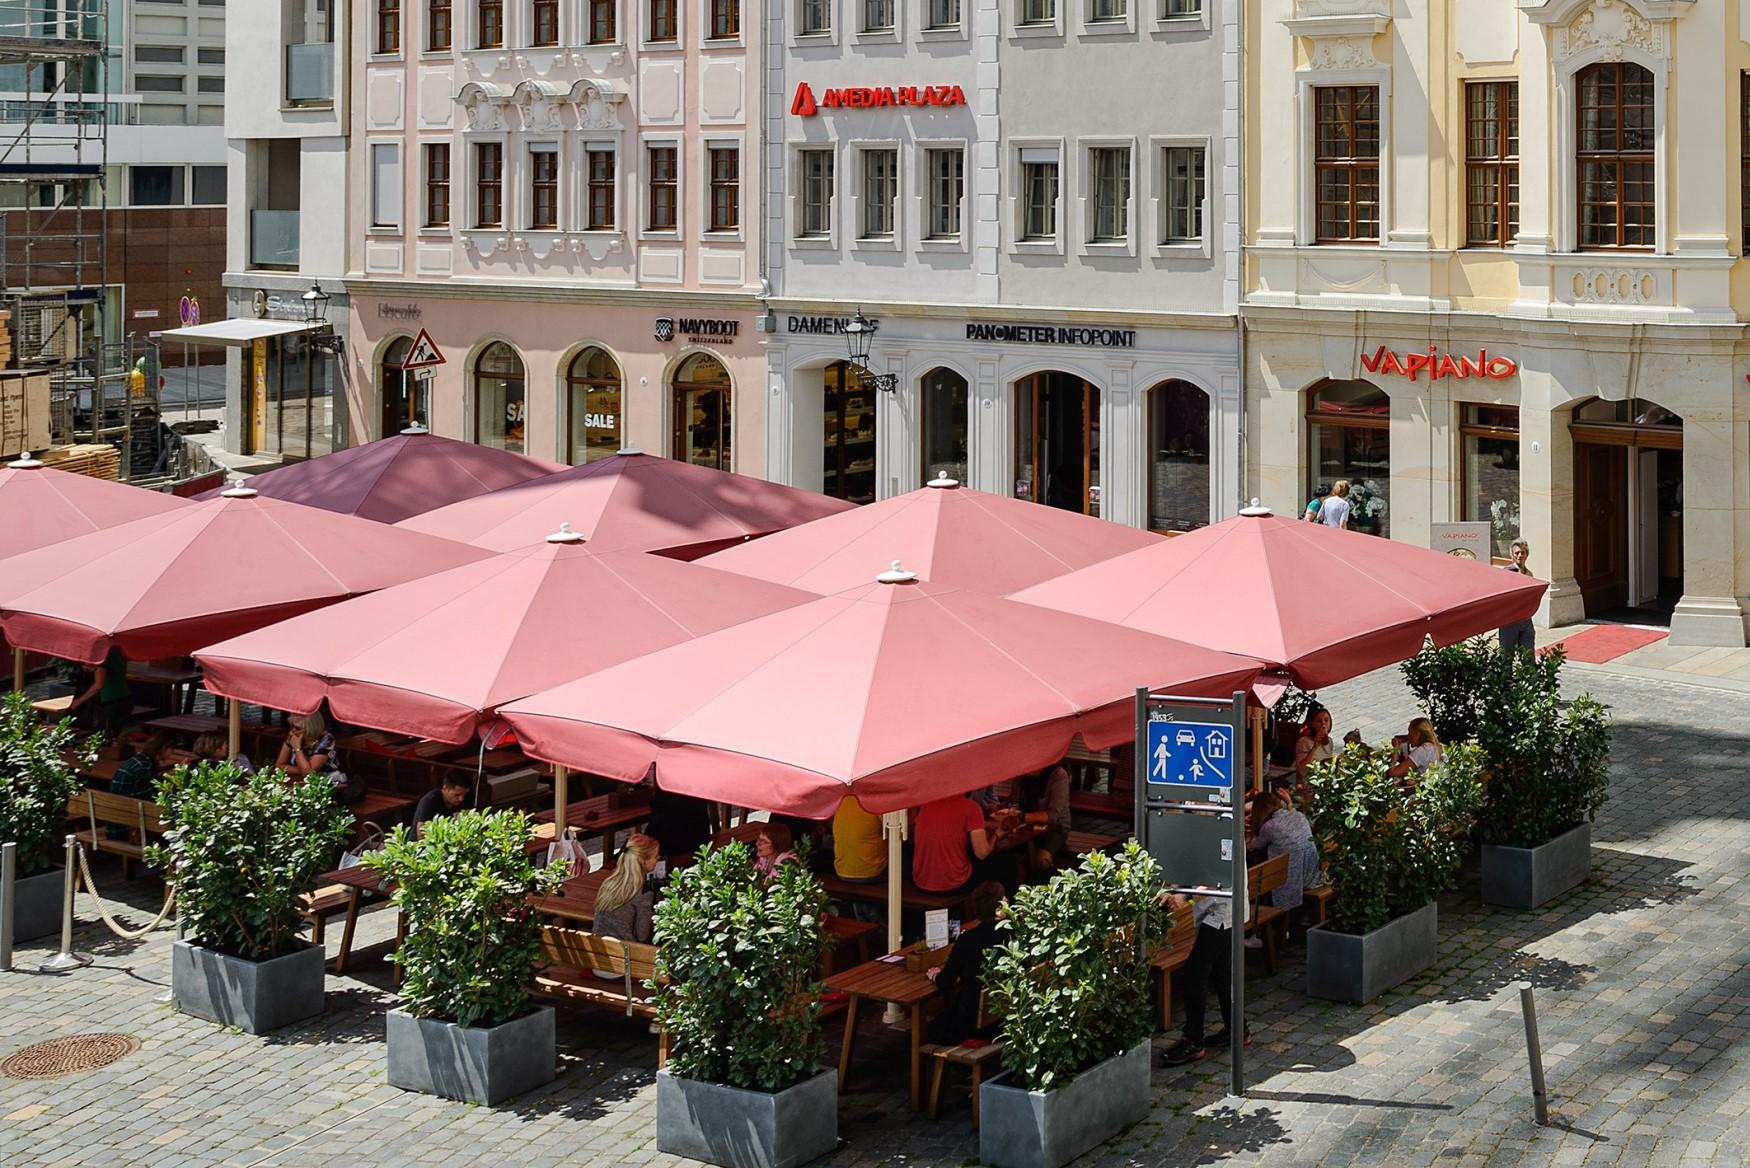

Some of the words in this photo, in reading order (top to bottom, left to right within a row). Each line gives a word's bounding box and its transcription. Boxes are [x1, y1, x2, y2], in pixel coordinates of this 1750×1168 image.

[821, 87, 896, 108] AMEDIA
[897, 85, 967, 106] PLAZA
[679, 318, 739, 336] NAVYBOOT
[966, 323, 1056, 343] PANOMETER
[1058, 328, 1137, 348] INFOPOINT
[584, 413, 615, 430] SALE
